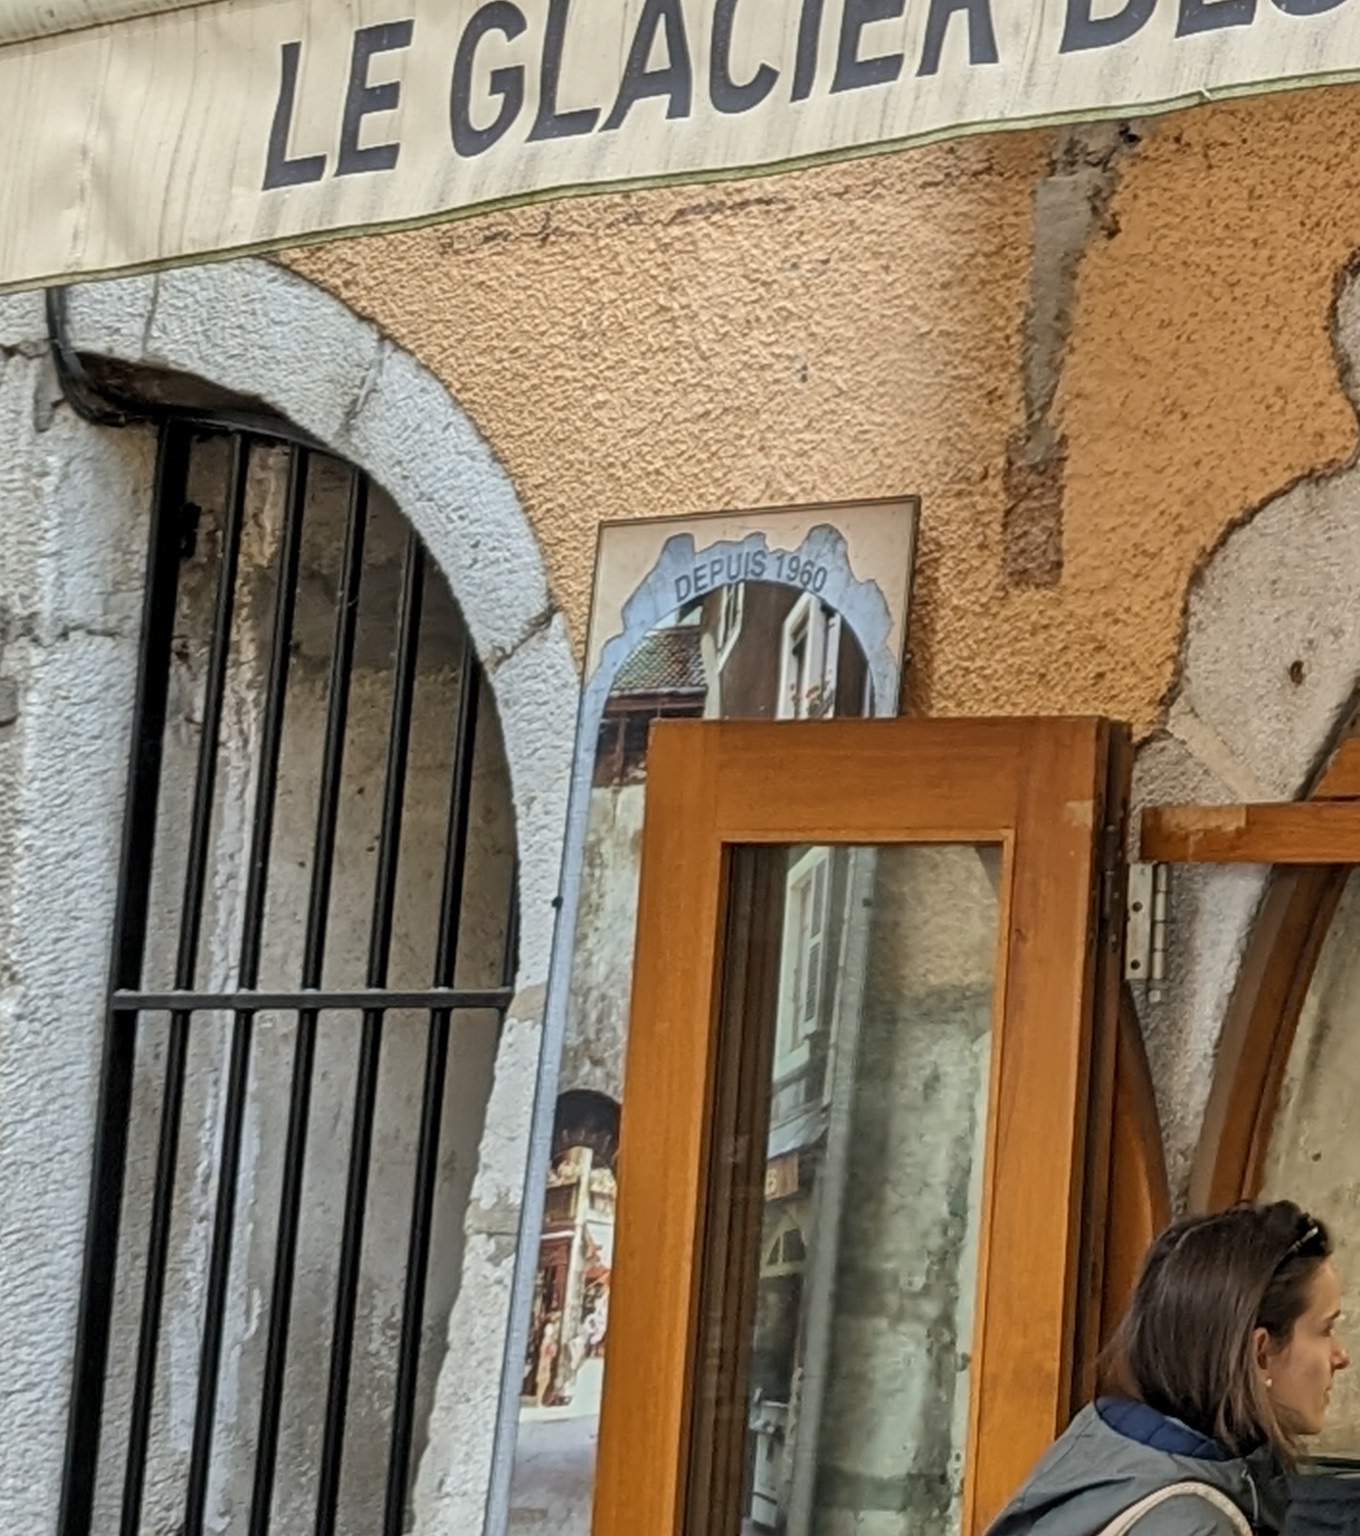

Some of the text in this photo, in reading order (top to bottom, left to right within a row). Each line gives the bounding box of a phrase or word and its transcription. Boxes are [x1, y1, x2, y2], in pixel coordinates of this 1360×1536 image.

[262, 19, 414, 192] LE
[674, 550, 828, 603] DEPUIS 1960
